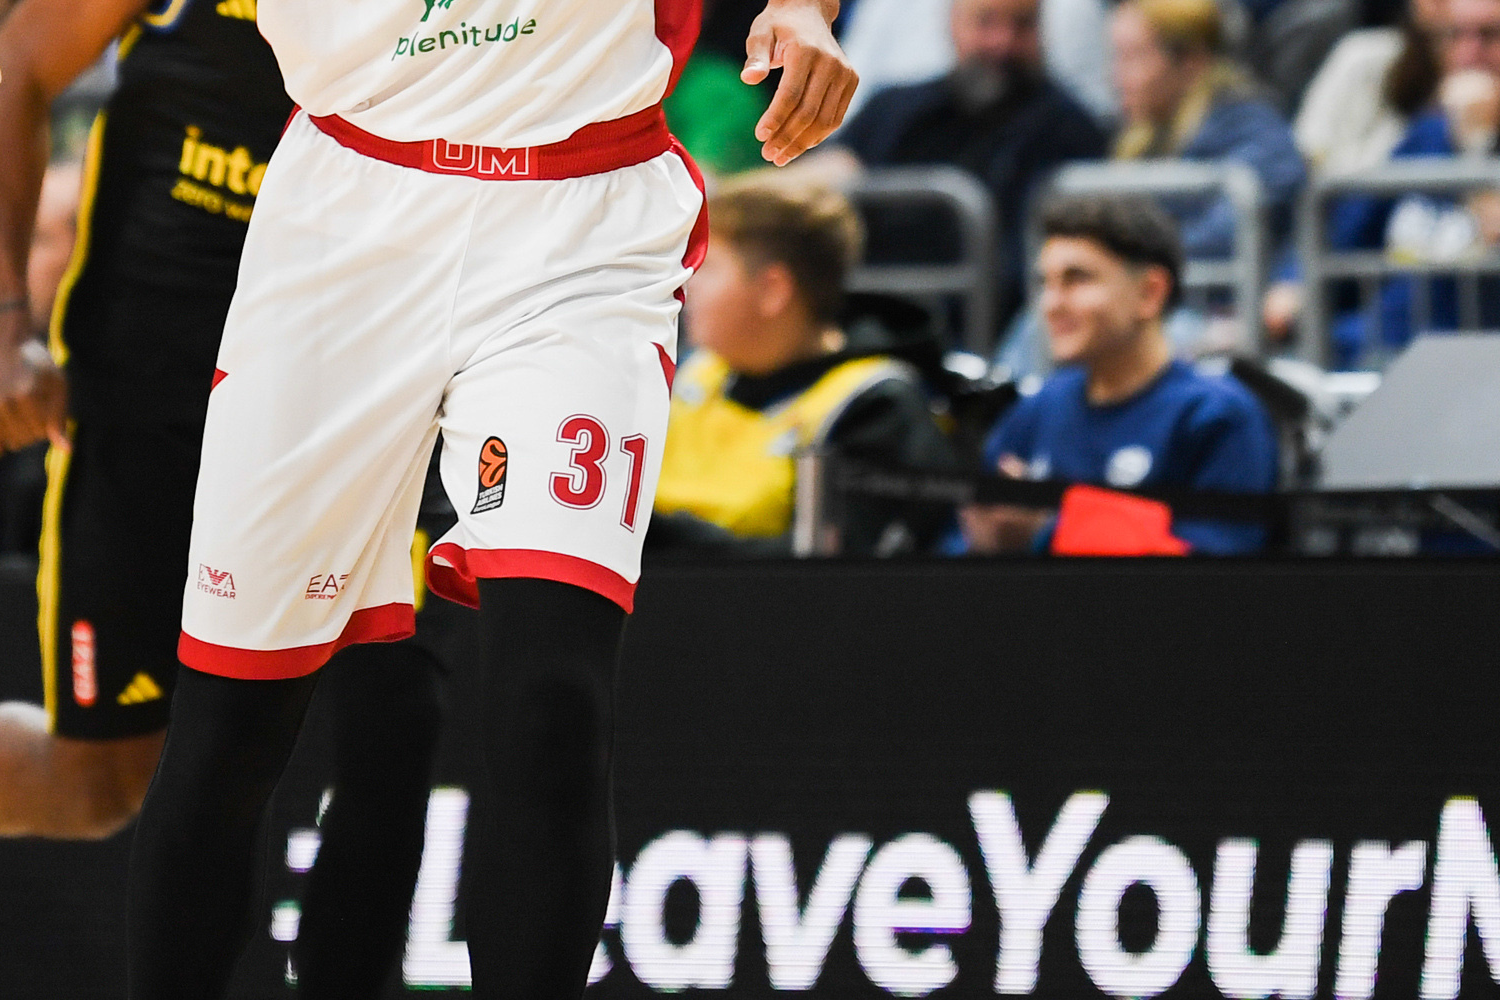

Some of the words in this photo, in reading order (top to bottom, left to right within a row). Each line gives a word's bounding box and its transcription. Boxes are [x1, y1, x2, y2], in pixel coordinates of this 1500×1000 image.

[390, 15, 538, 62] plenitude
[548, 413, 649, 534] 31
[196, 581, 236, 600] EYEWEAR
